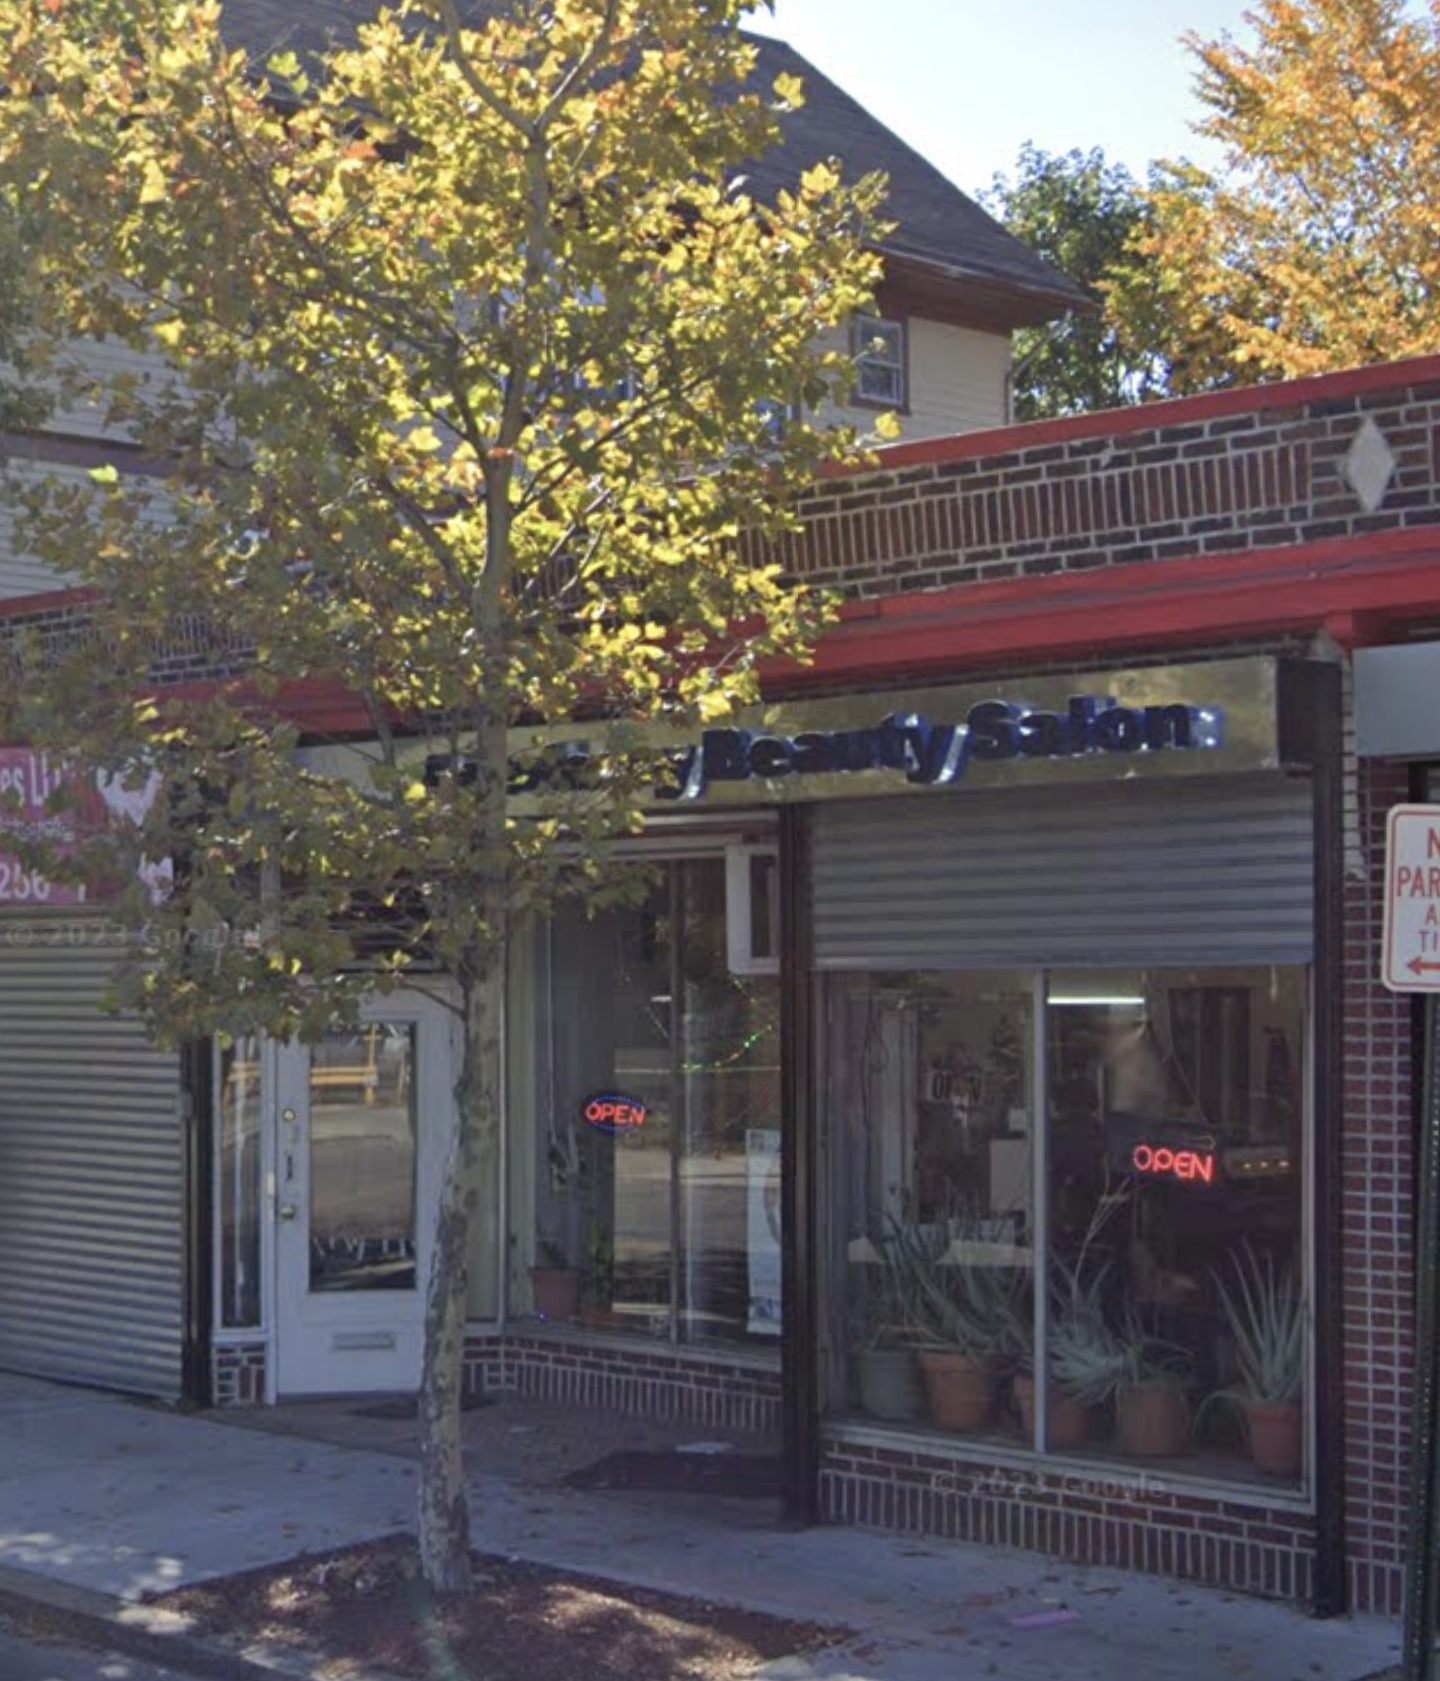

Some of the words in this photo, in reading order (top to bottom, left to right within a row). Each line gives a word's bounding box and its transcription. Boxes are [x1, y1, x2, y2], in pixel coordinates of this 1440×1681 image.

[702, 711, 970, 785] Beauty
[966, 695, 1224, 758] Salon
[584, 1101, 646, 1126] OPEN
[1133, 1145, 1214, 1183] OPEN
